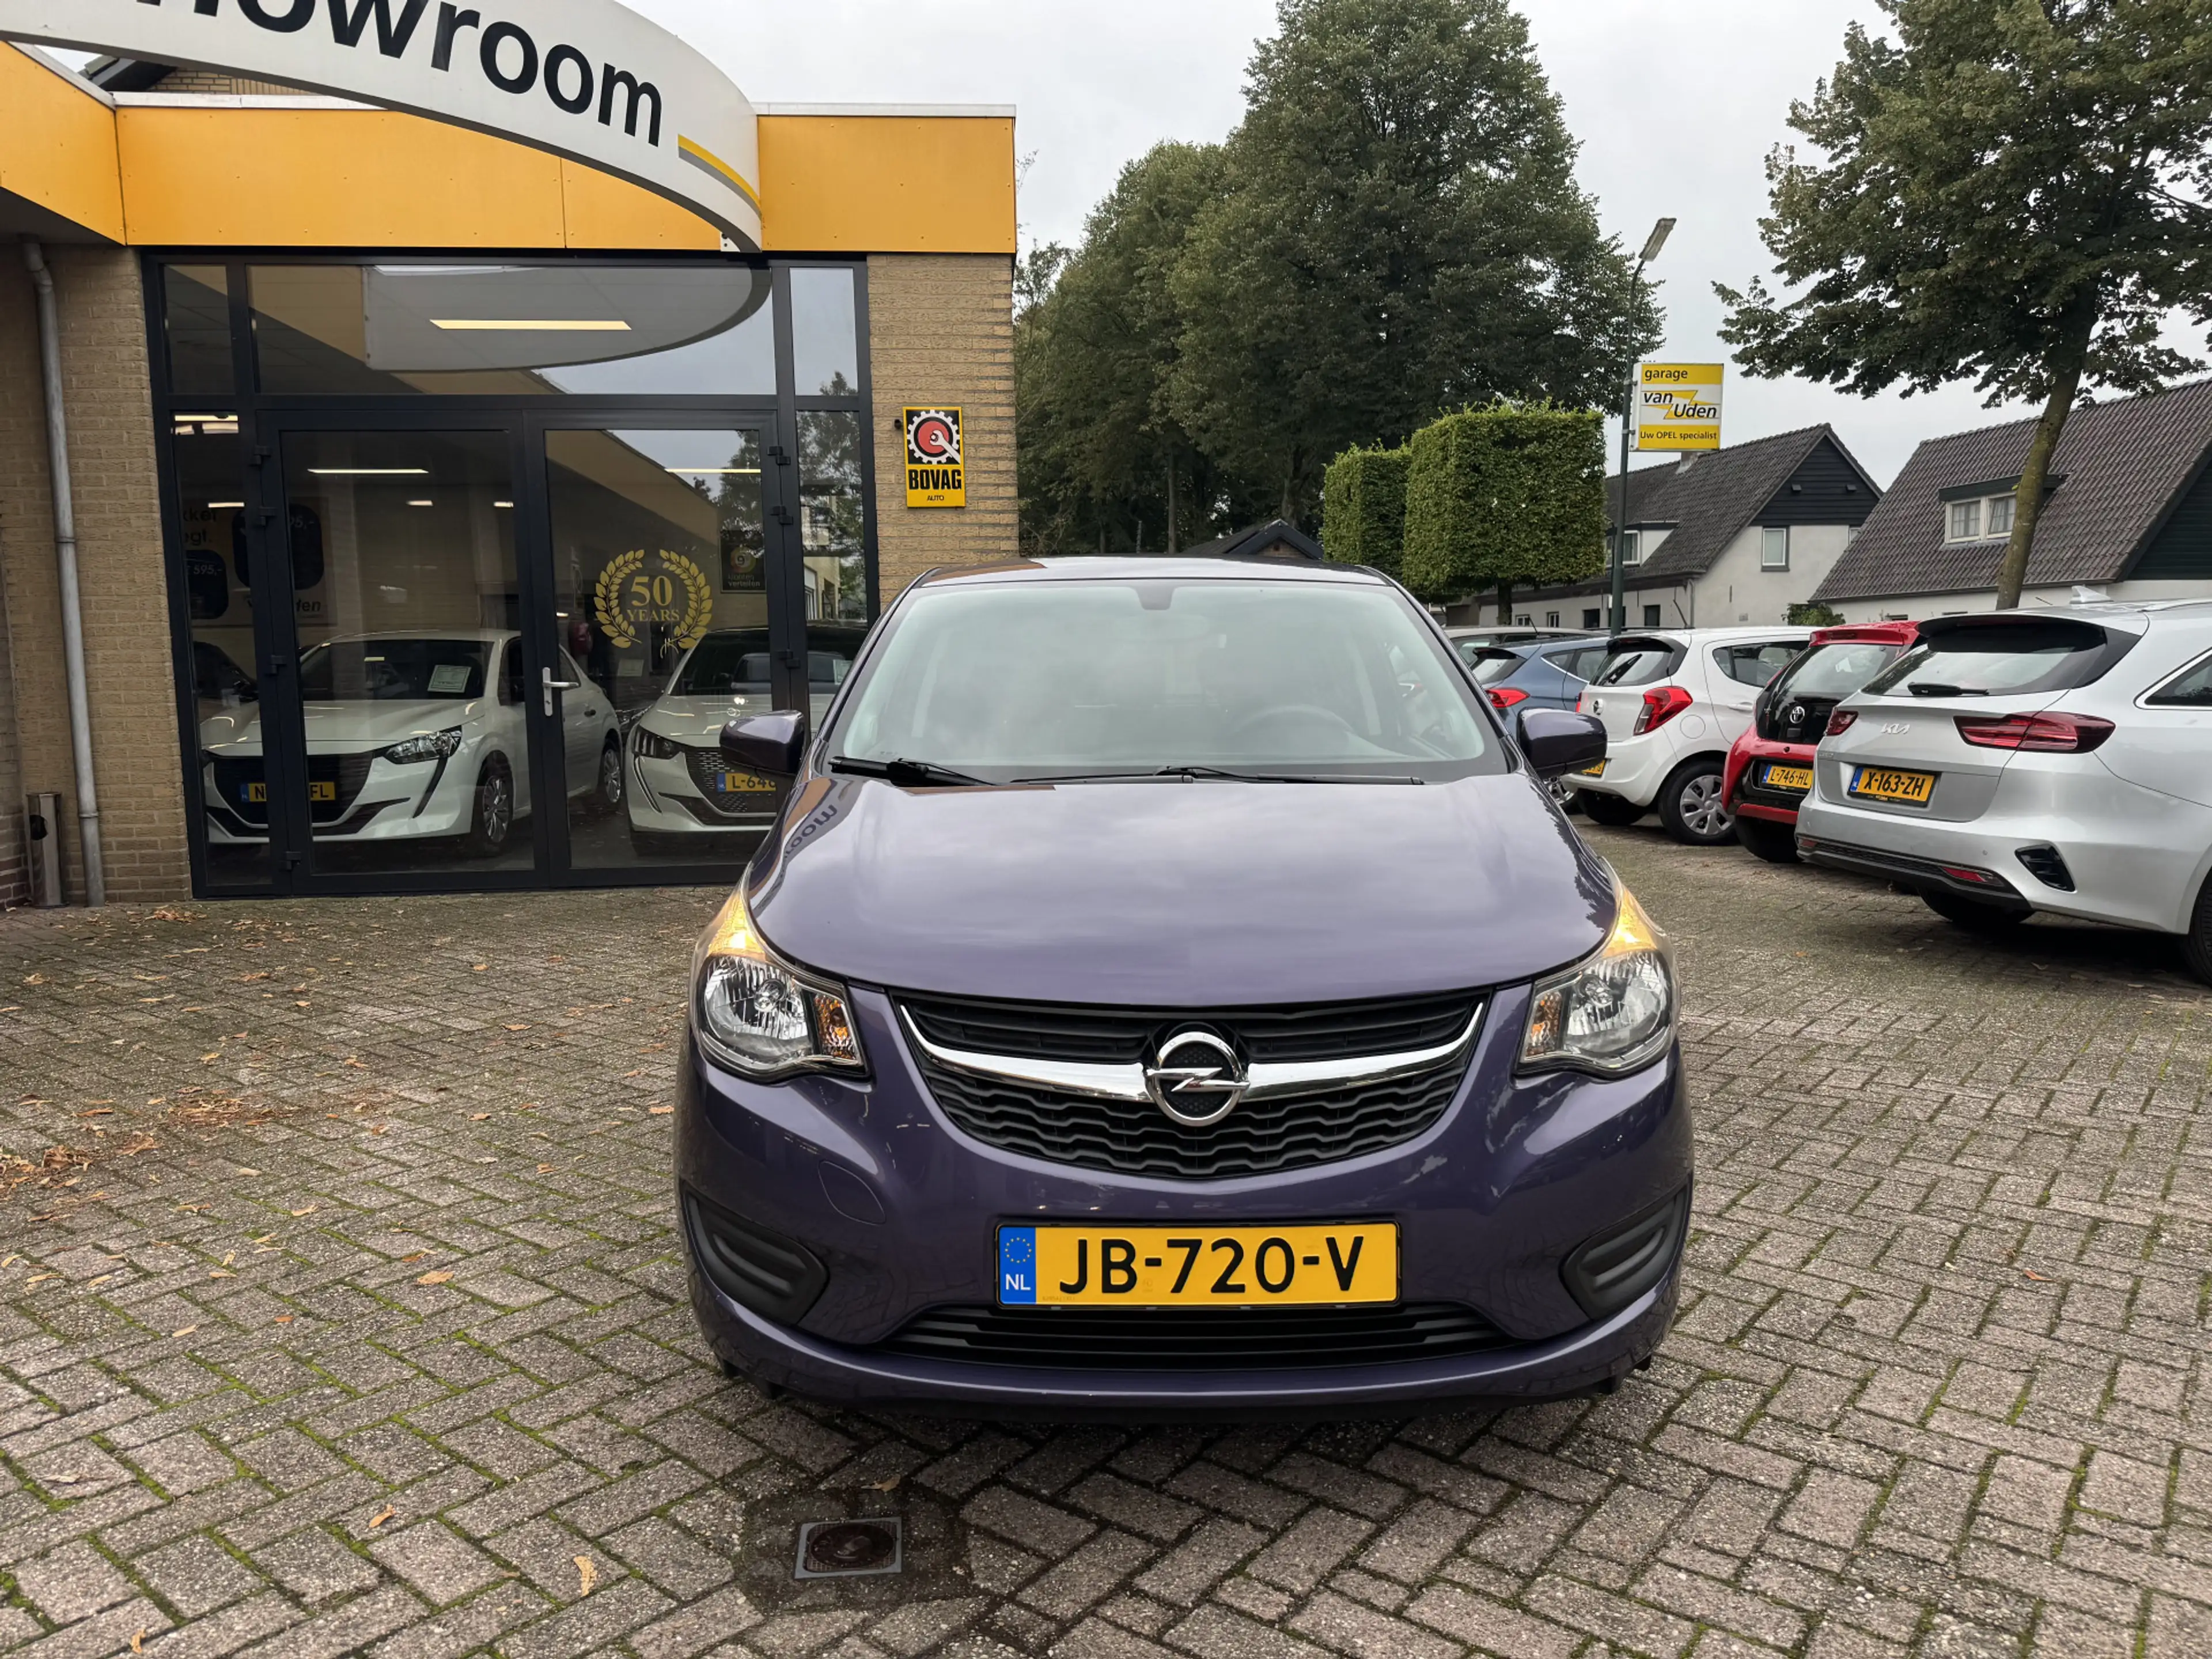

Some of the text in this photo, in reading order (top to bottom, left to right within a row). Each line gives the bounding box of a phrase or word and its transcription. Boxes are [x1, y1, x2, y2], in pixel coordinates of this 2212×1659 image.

[137, 0, 664, 147] wroom
[1645, 369, 1688, 381] garage
[1643, 392, 1673, 403] van
[1674, 404, 1717, 418] Uden
[1679, 431, 1717, 441] specialist
[908, 469, 961, 490] BOVAG
[631, 575, 672, 607] 50
[626, 609, 680, 622] YEARS
[1770, 768, 1808, 785] L-746-HL
[1864, 772, 1926, 797] X-163-ZH
[1005, 1236, 1363, 1294] NL JB-720-V
